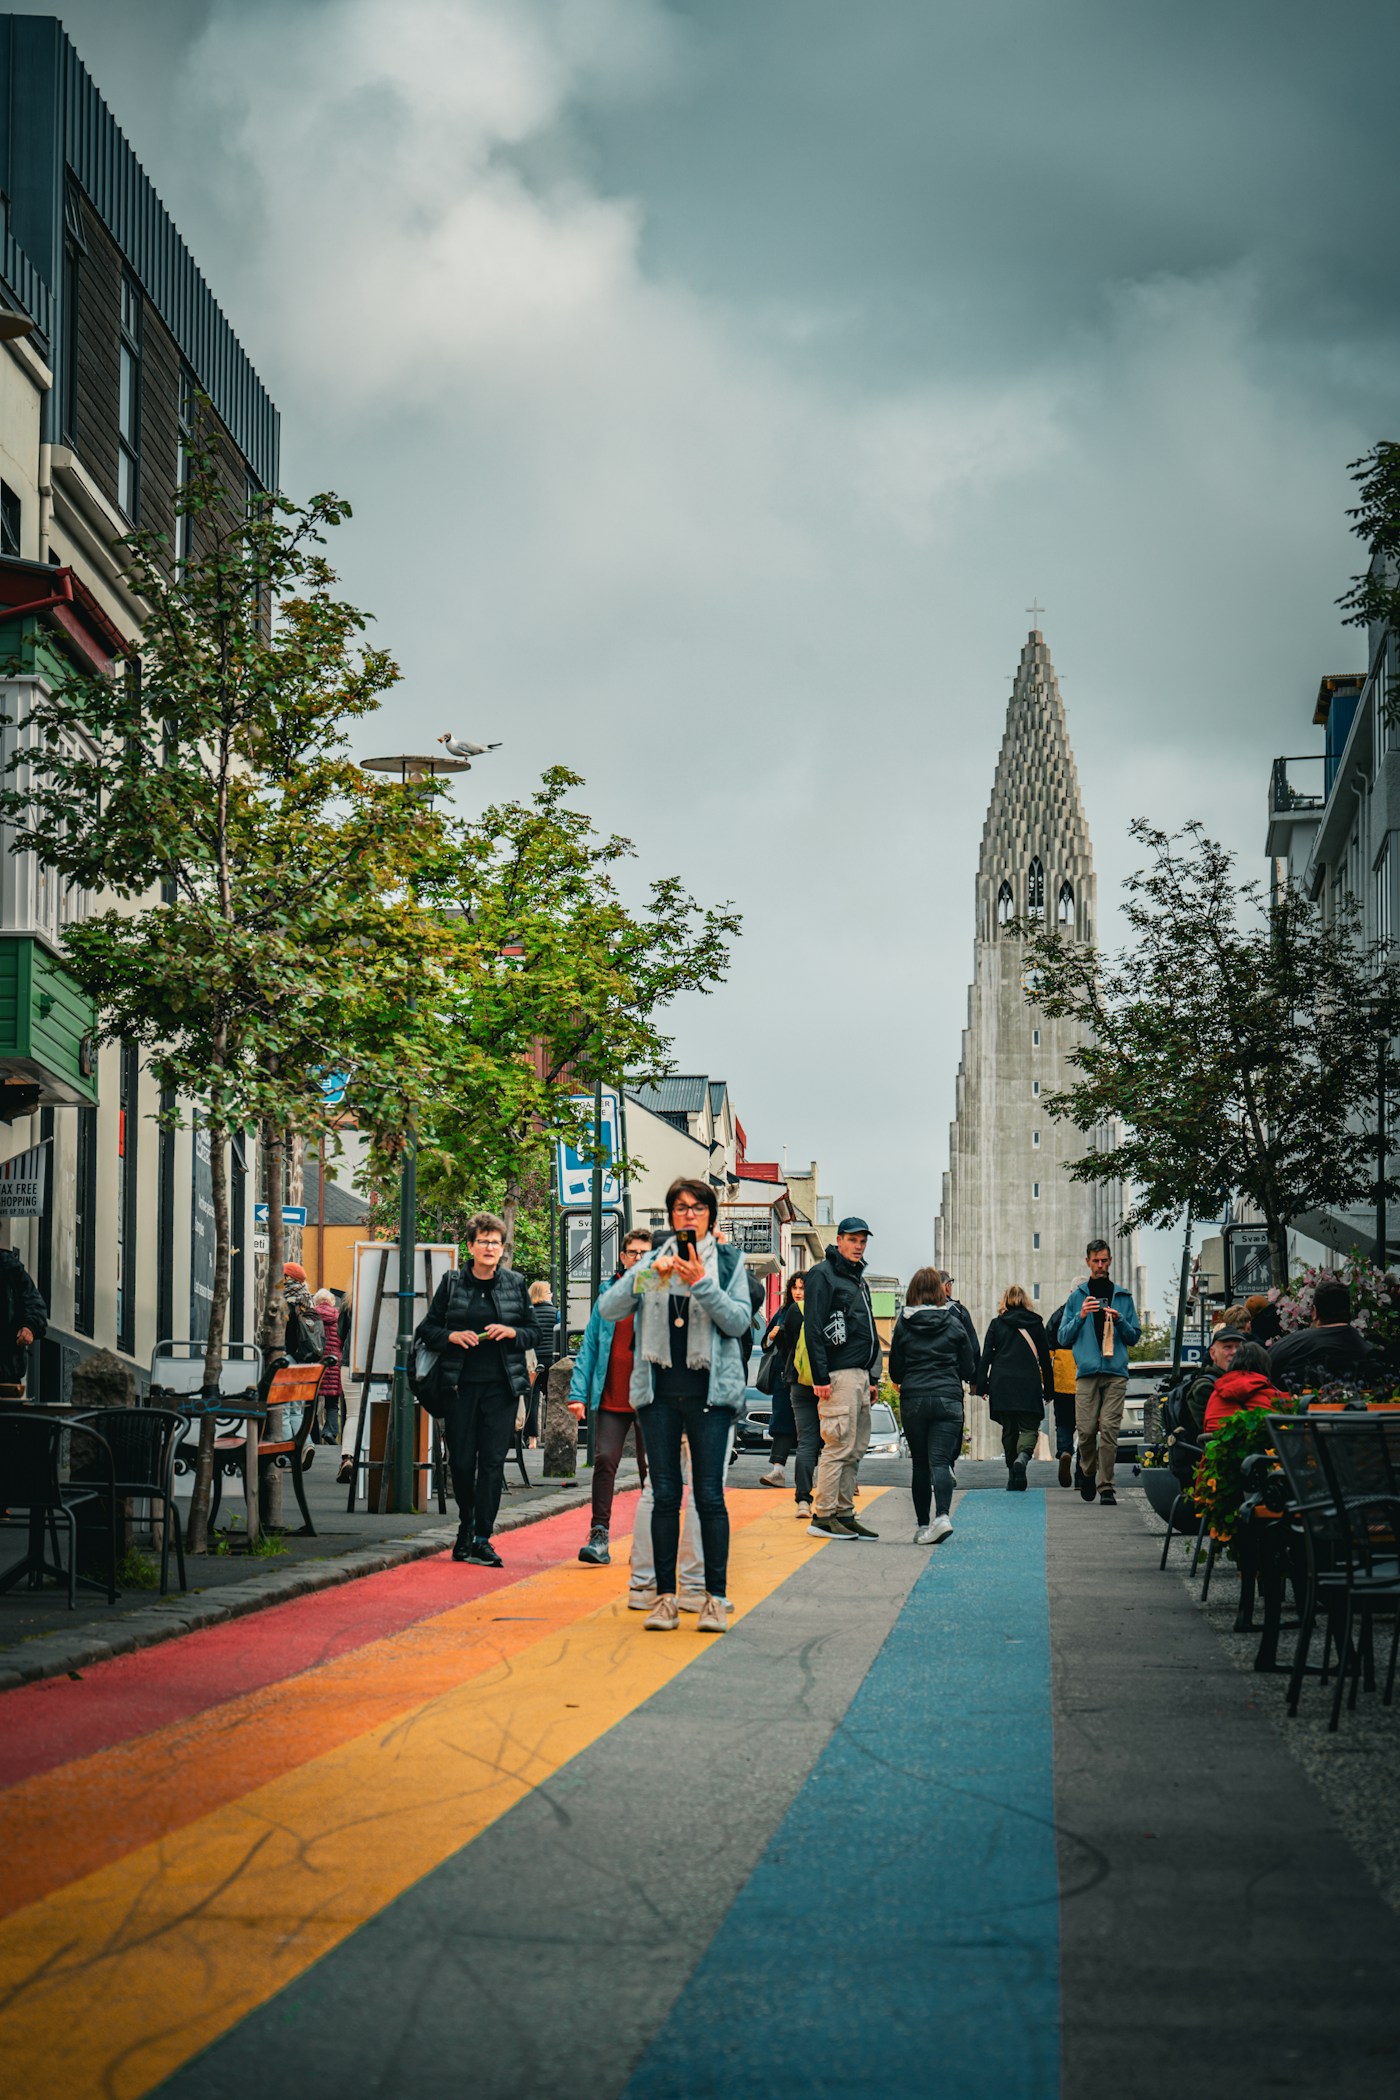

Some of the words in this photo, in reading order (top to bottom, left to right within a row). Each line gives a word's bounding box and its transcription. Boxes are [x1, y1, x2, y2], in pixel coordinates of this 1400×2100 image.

[16, 1183, 37, 1195] FREE
[0, 1196, 37, 1207] HOPPING
[1187, 1349, 1201, 1362] P
